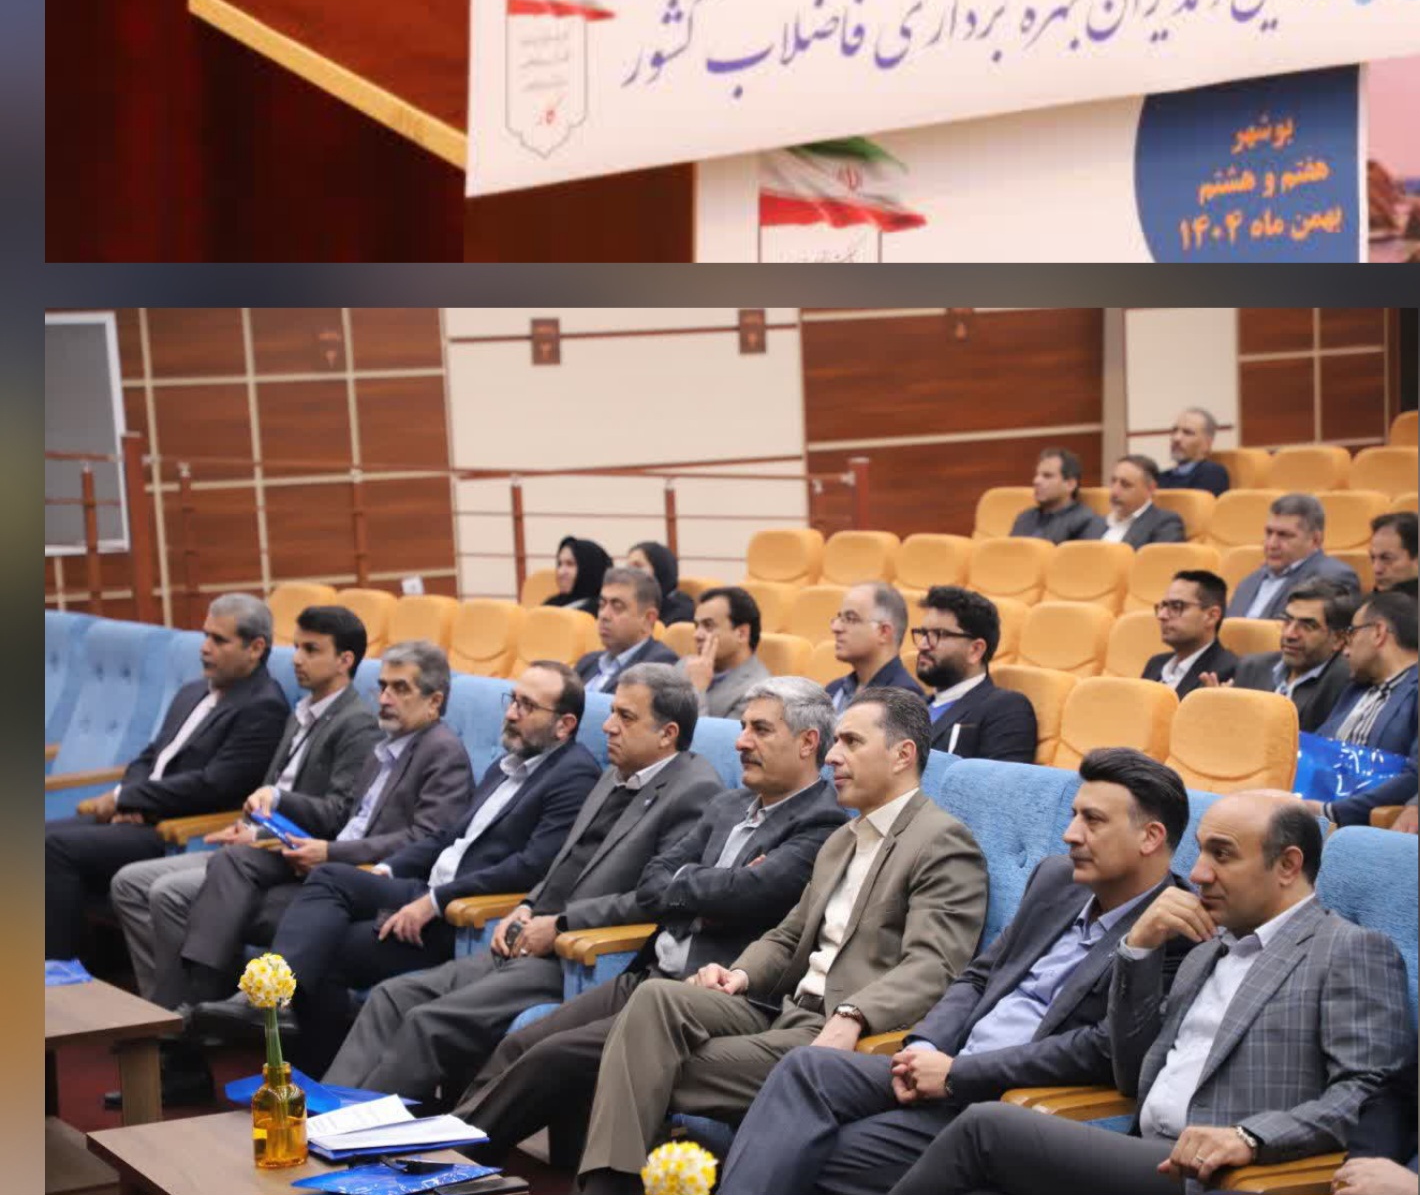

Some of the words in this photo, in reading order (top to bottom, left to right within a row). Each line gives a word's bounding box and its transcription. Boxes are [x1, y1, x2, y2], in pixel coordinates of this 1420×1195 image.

[1231, 113, 1295, 155] بوشهر
[1261, 171, 1275, 198] و
[1180, 209, 1243, 251] ۱۴۰۴
[1250, 208, 1285, 238] ماه
[1291, 207, 1344, 241] بهمن
